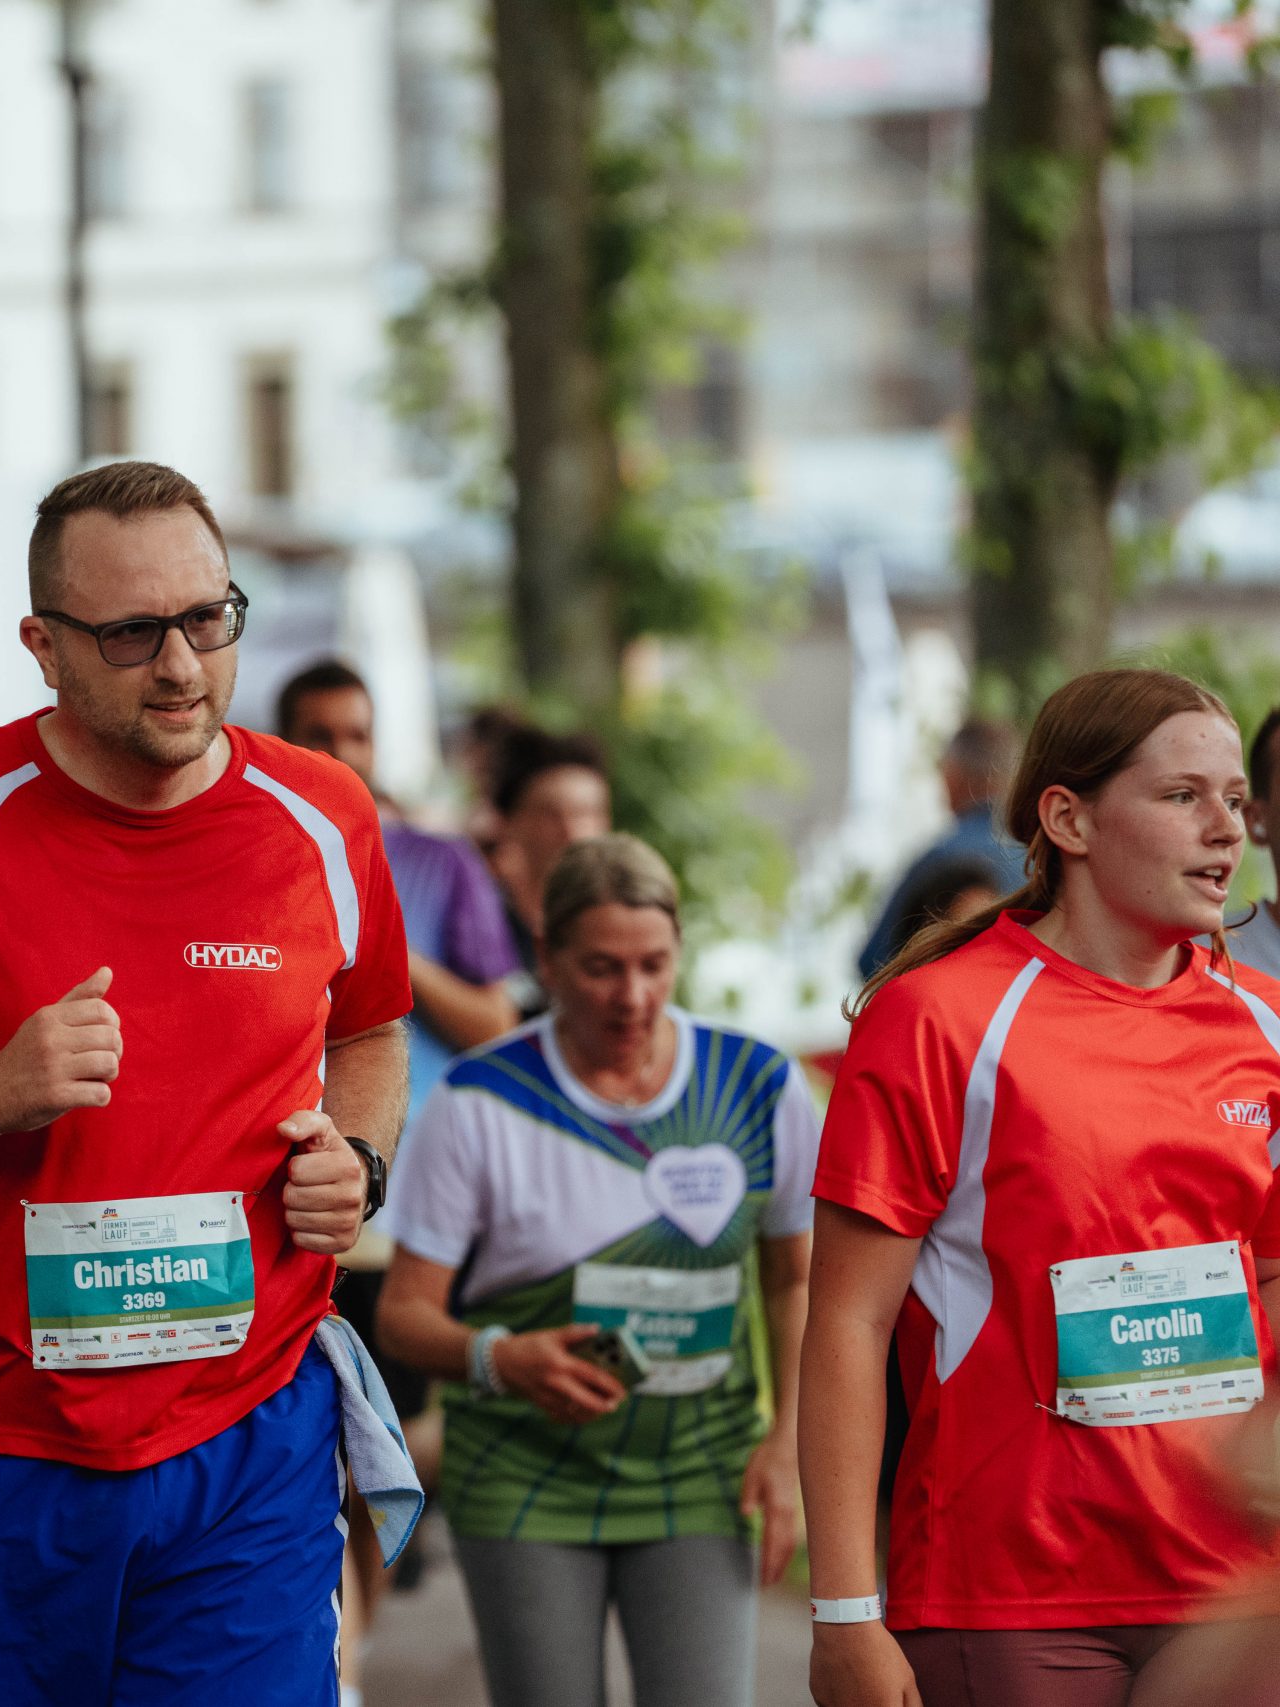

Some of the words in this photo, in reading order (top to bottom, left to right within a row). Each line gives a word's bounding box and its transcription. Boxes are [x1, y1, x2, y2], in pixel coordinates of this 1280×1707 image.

[190, 945, 277, 968] HYDAC
[1221, 1102, 1271, 1127] HYDA
[104, 1221, 128, 1229] FIRMEN
[104, 1229, 128, 1240] LAUF
[73, 1254, 209, 1289] Christian
[1122, 1283, 1144, 1294] LAUF
[122, 1291, 166, 1311] 3369
[1110, 1308, 1204, 1345] Carolin
[42, 1334, 58, 1343] dm
[1141, 1346, 1180, 1367] 3375
